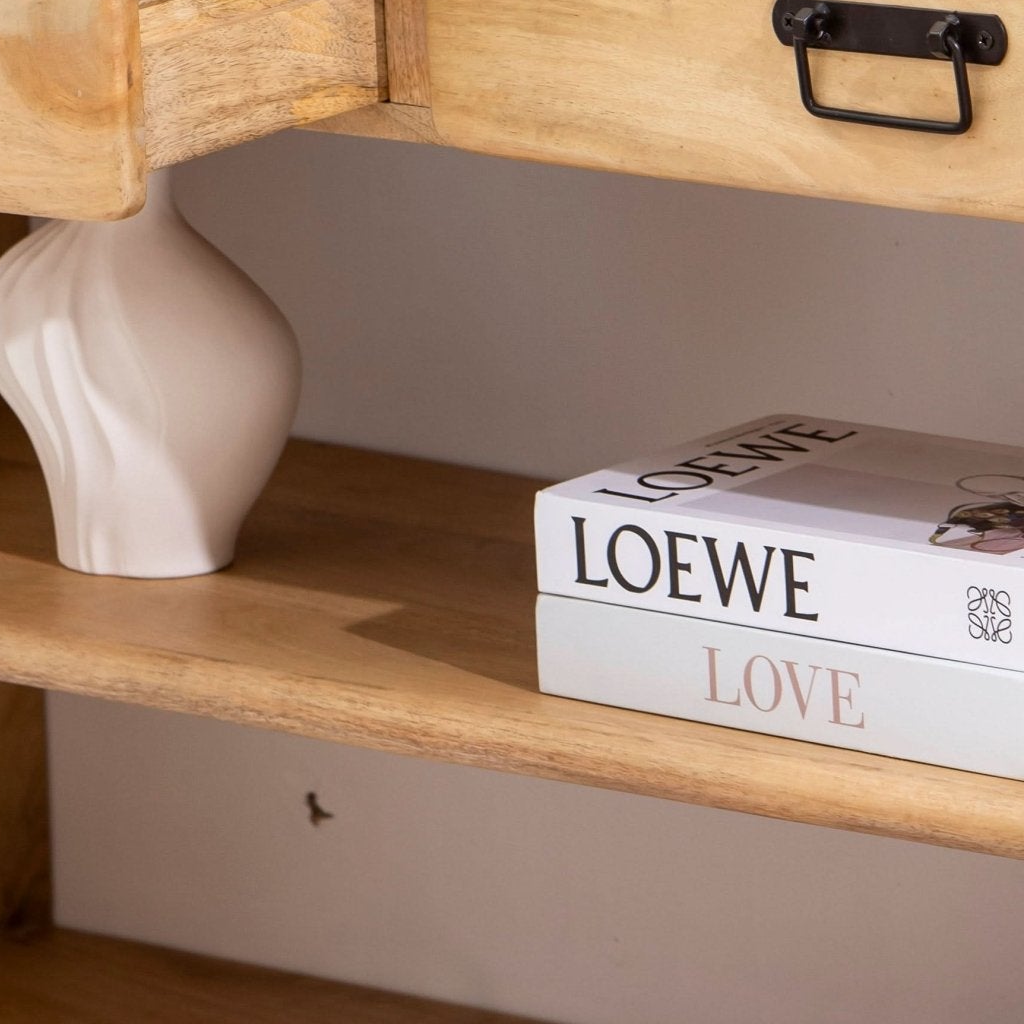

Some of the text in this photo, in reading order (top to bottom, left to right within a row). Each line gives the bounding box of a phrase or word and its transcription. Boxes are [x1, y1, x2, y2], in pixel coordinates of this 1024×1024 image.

[593, 423, 858, 503] LOEWE
[570, 516, 819, 622] LOEWE
[702, 646, 865, 729] LOVE
